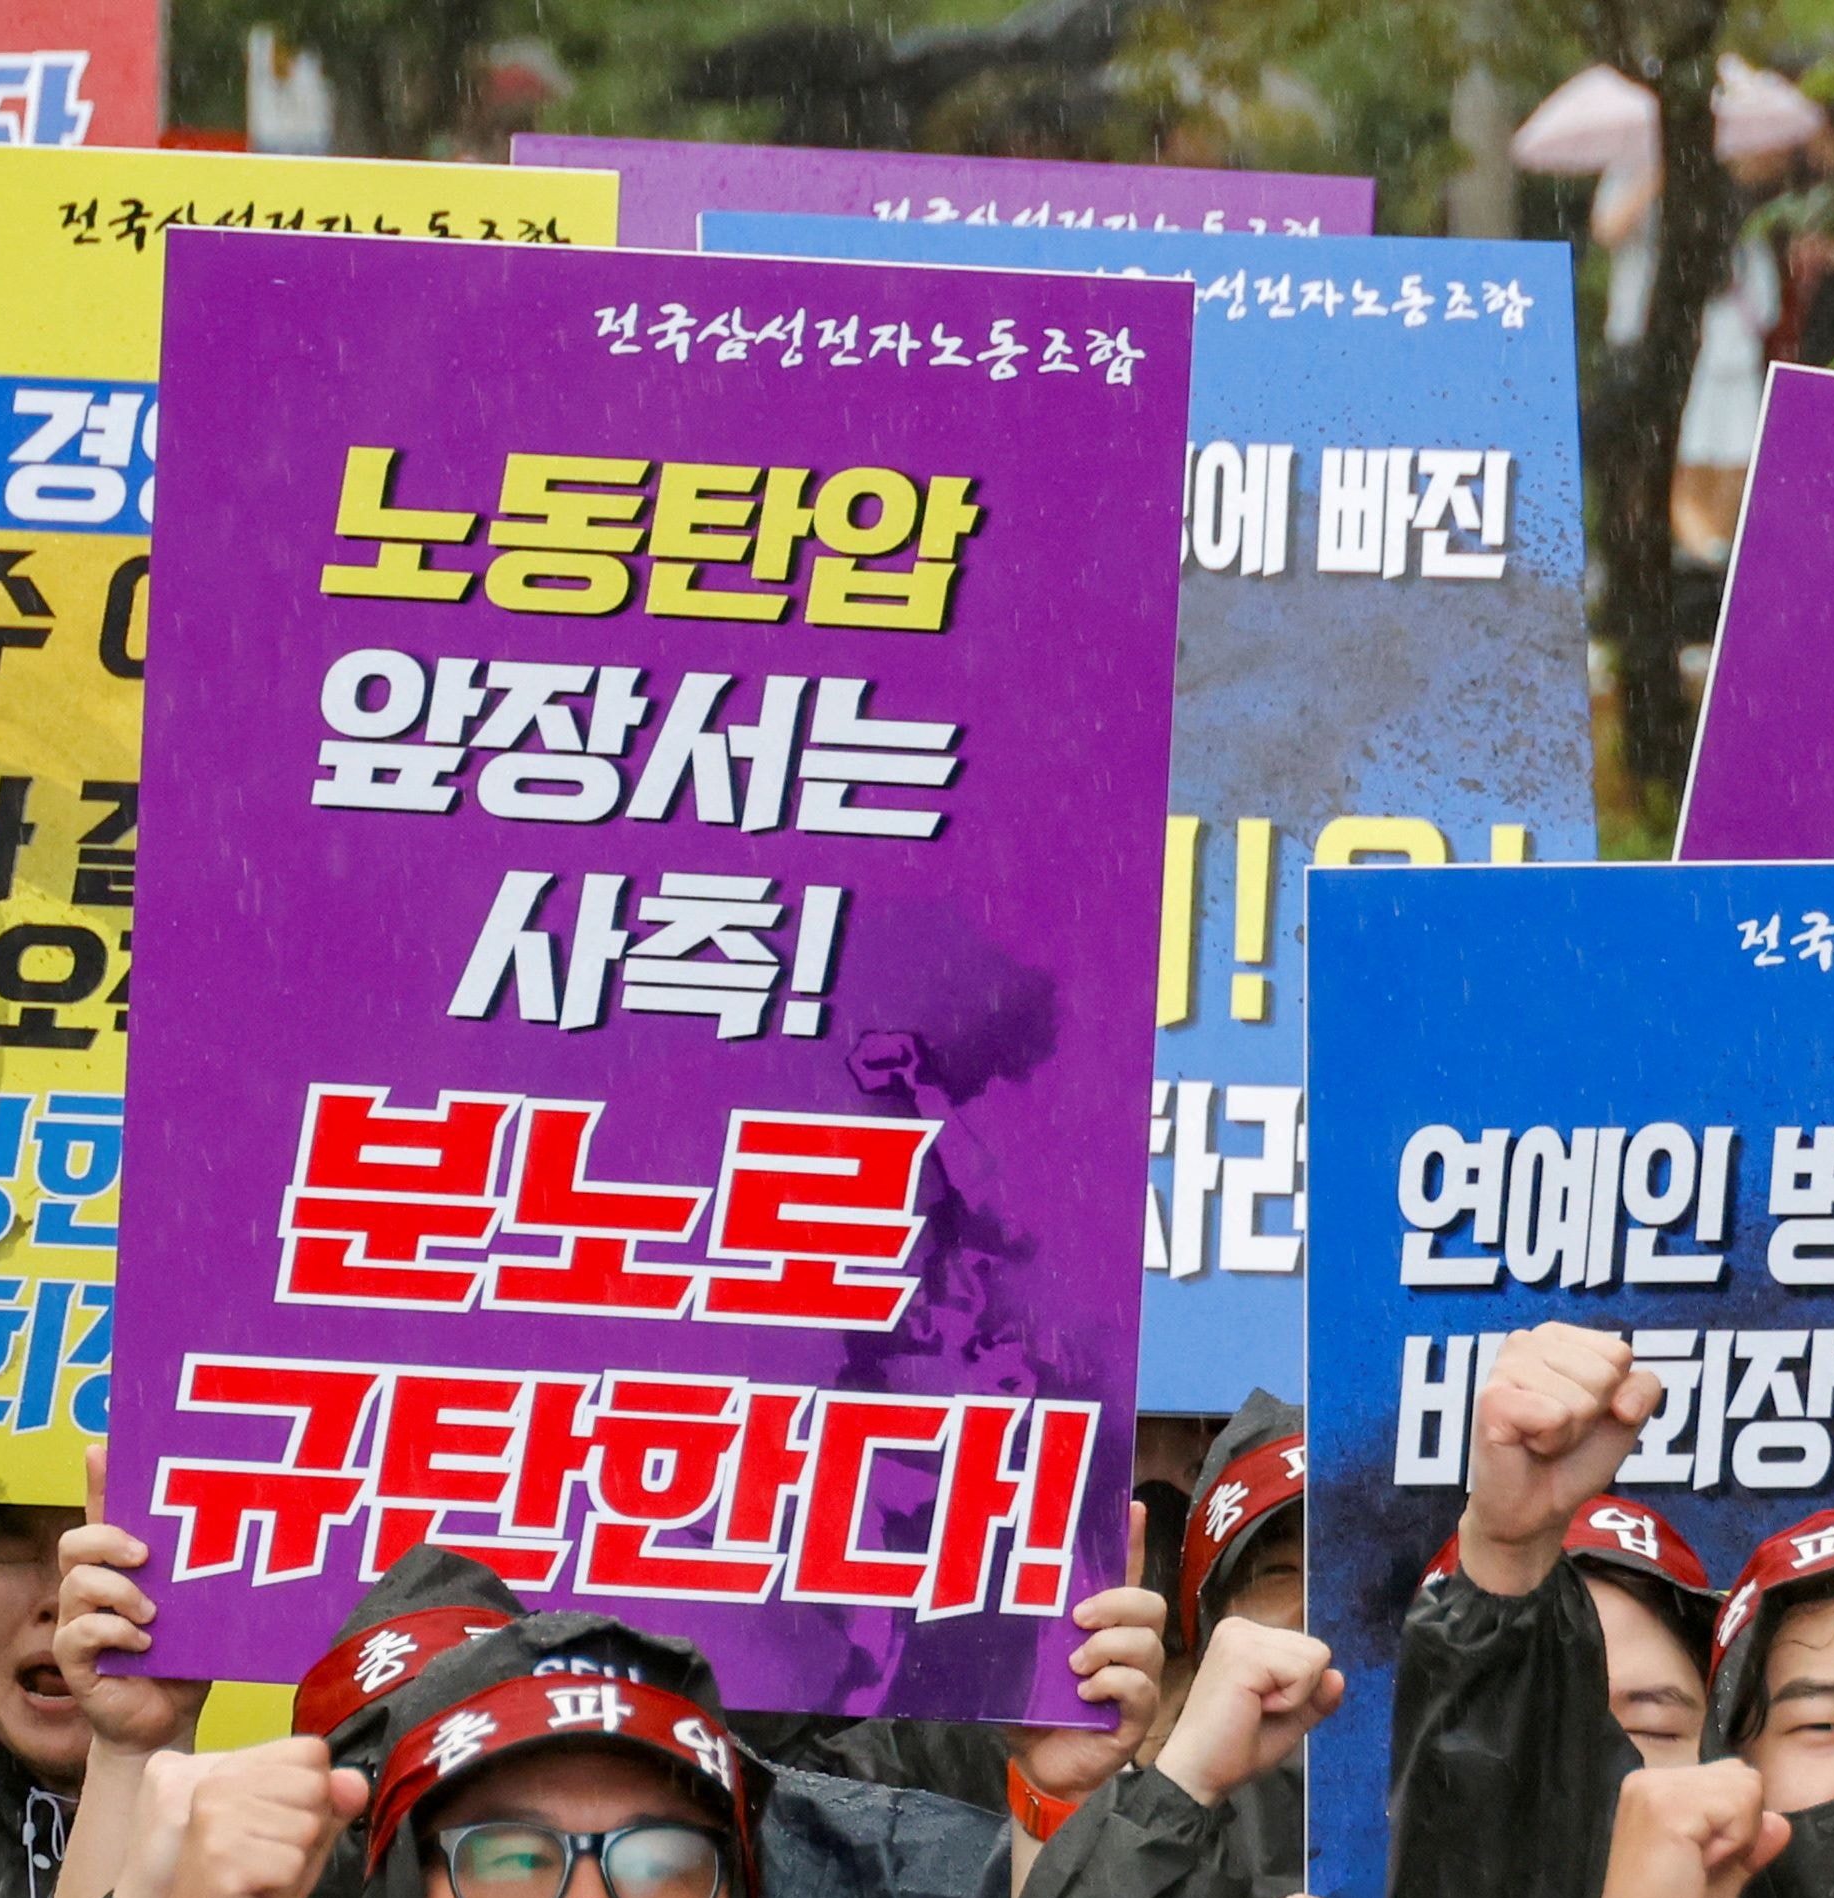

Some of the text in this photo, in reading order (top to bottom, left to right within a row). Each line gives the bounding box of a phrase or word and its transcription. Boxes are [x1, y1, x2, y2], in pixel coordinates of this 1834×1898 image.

[592, 303, 1145, 386] 전국삼성전자노동조합
[1095, 266, 1534, 330] 성전자노동조합
[3, 387, 159, 525] 경
[319, 447, 985, 631] 노동탄압
[1182, 440, 1511, 580] 에 빠진
[310, 648, 959, 840] 앞장서는
[446, 870, 846, 1039] 사측!
[273, 1082, 945, 1332] 분노로
[1397, 1121, 1737, 1288] 연예인
[150, 1352, 1101, 1622] 규탄한다!
[424, 1684, 733, 1792] 총파업
